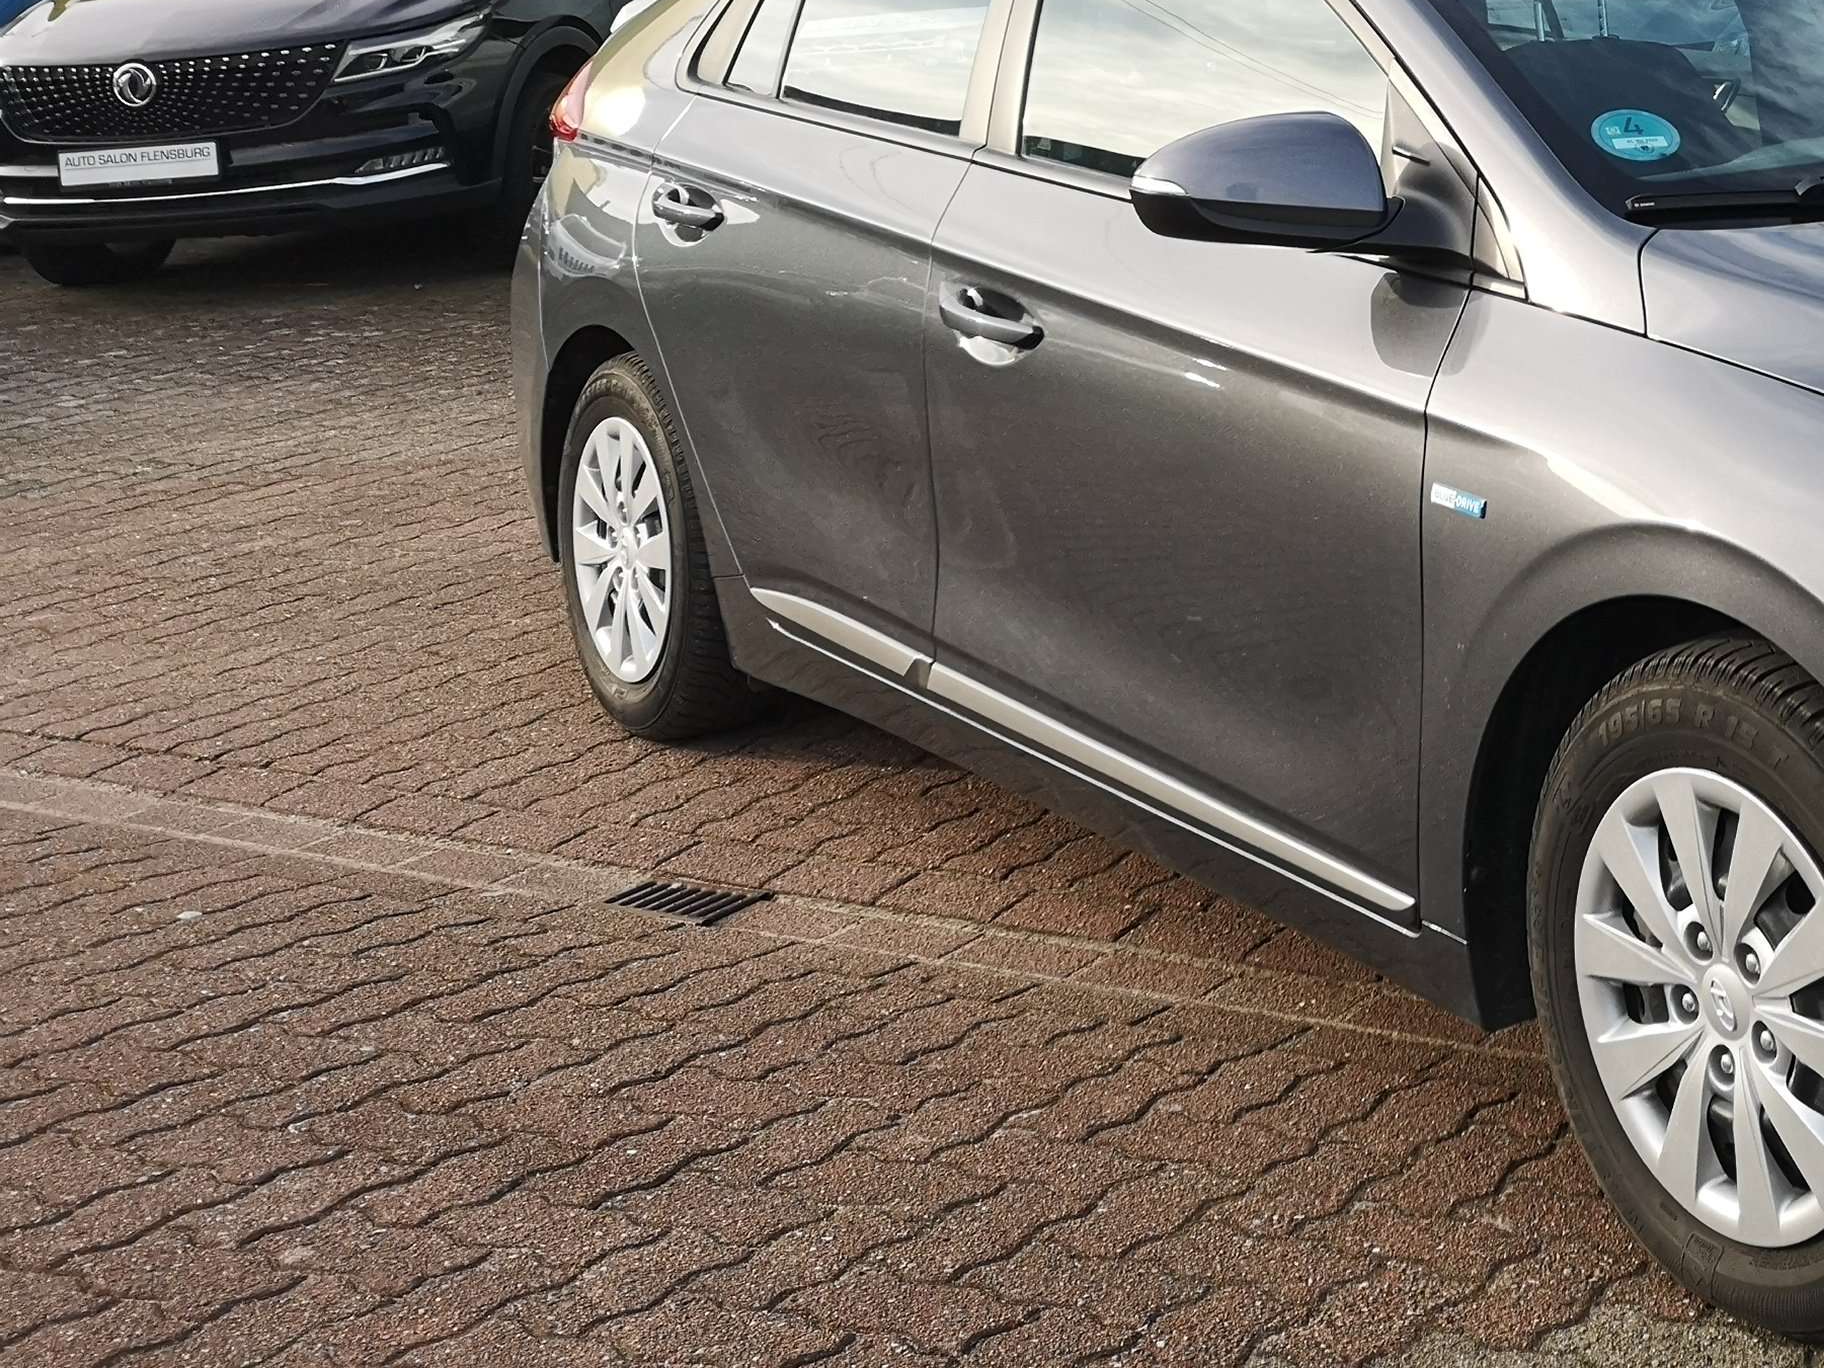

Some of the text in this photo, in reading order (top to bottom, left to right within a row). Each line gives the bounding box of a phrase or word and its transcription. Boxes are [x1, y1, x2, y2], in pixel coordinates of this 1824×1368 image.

[64, 147, 211, 168] AUTO SALON FLENSBURG
[1695, 703, 1716, 729] R
